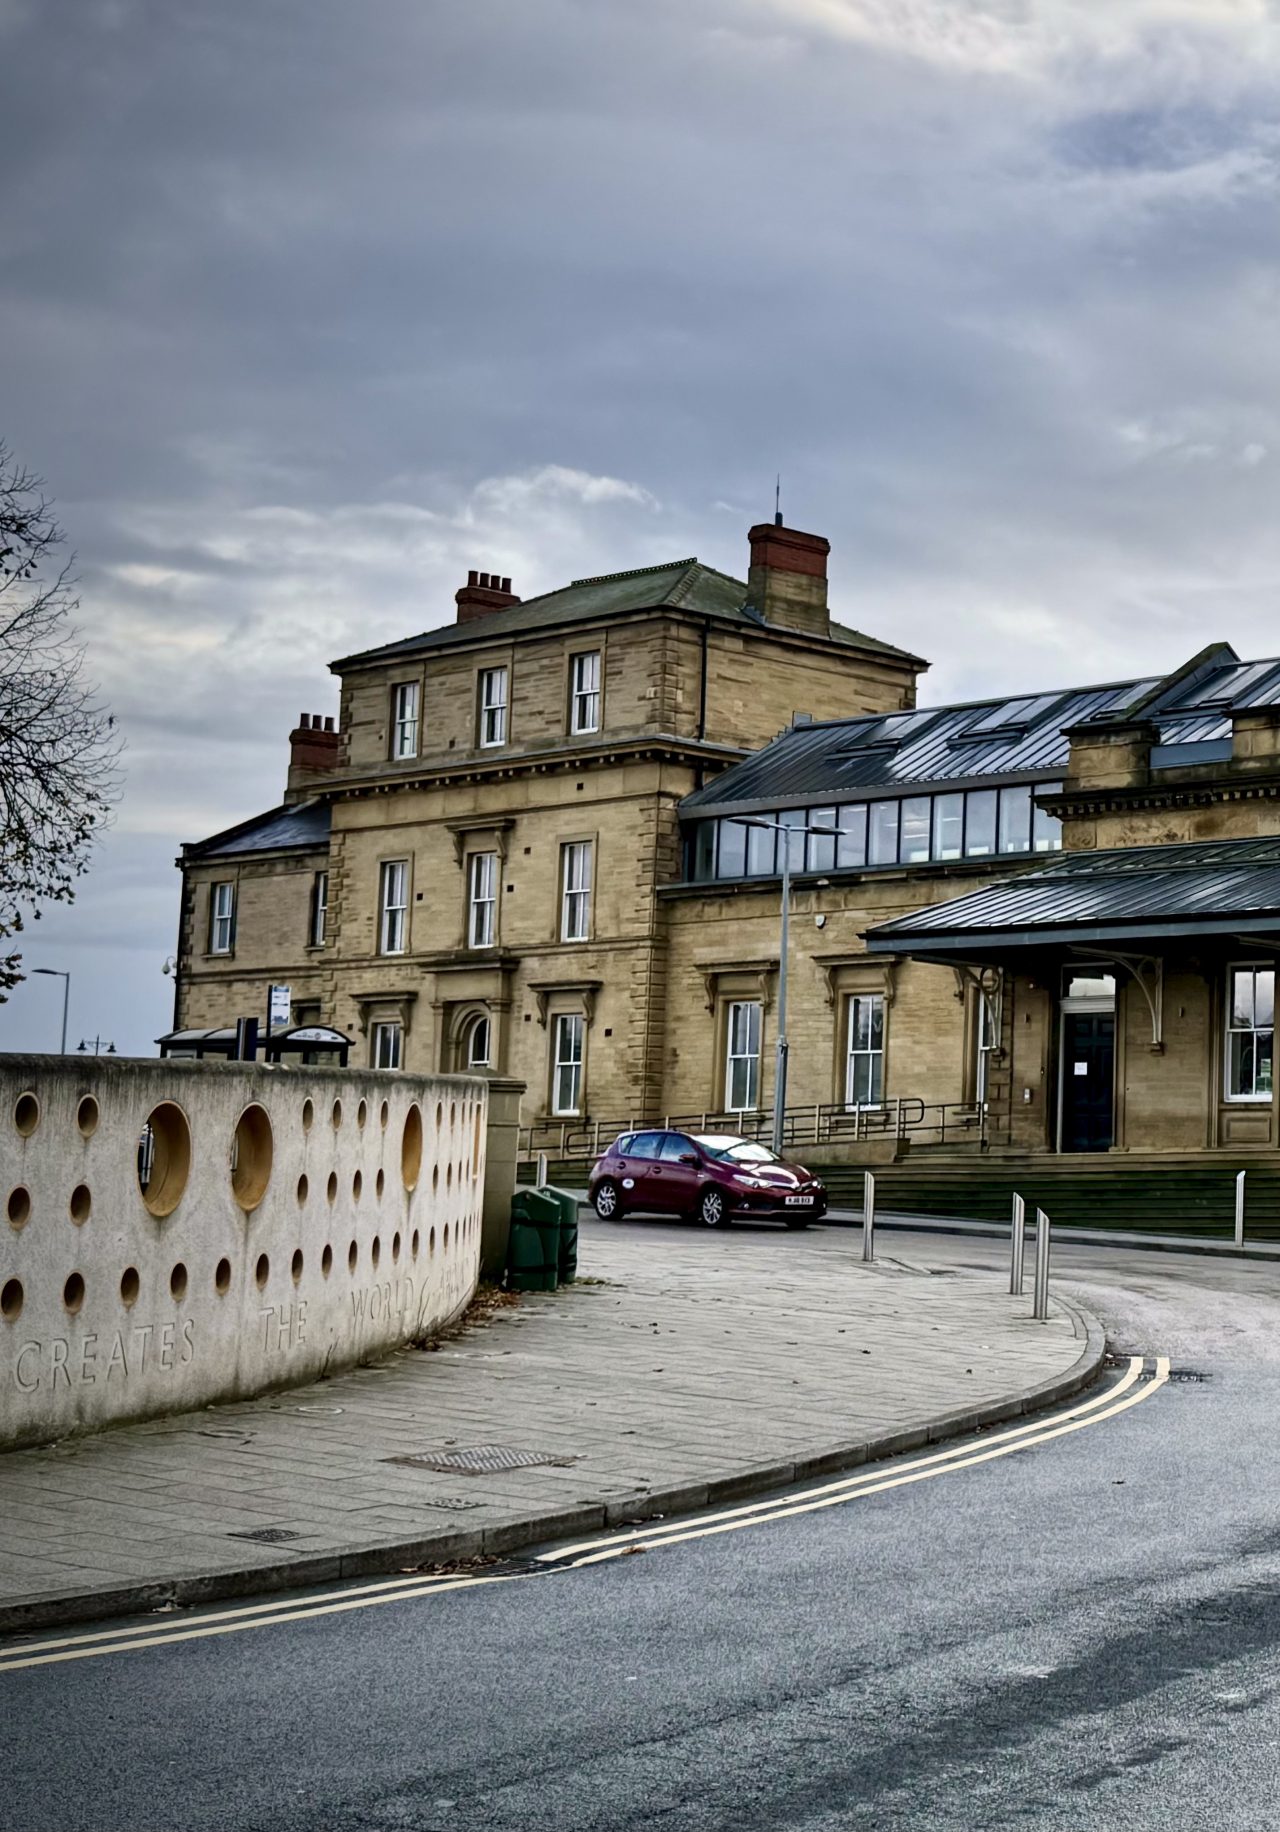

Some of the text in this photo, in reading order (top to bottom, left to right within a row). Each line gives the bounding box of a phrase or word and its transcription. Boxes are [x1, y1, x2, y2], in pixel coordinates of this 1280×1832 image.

[16, 1318, 195, 1392] CREATES
[259, 1300, 307, 1351] THE
[350, 1277, 413, 1329] WORLD
